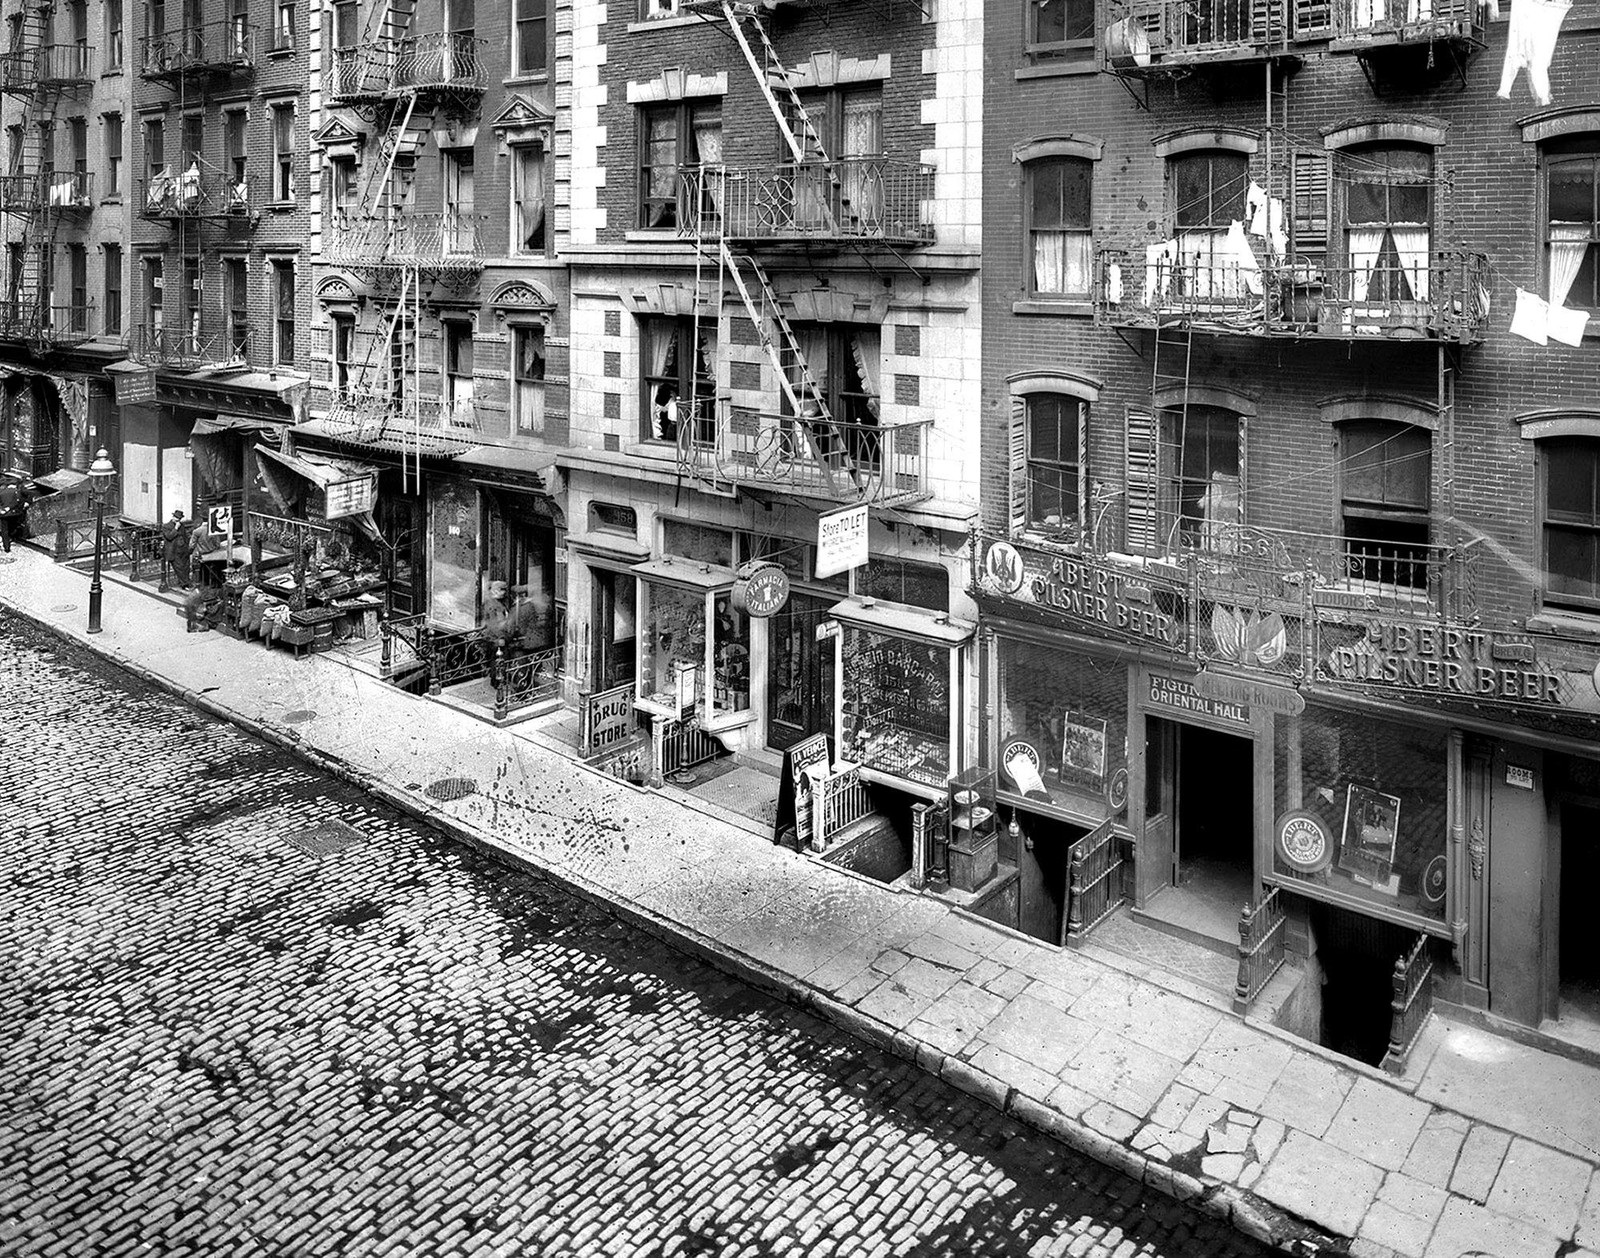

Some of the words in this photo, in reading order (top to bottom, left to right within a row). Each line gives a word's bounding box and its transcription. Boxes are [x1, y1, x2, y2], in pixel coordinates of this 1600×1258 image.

[616, 510, 633, 524] 158
[840, 517, 850, 532] TO
[851, 512, 866, 530] LET
[748, 575, 784, 597] FARMACIA
[750, 592, 784, 611] ITALIANA
[1031, 575, 1108, 624] PILSNER
[1115, 602, 1168, 642] BEER
[1336, 650, 1462, 693] PILSNER
[1476, 665, 1562, 705] BEER
[1151, 687, 1212, 714] ORIENTAL
[594, 701, 627, 729] DRUG
[593, 722, 628, 748] STORE
[794, 751, 803, 763] LA
[803, 737, 827, 758] VELOCE
